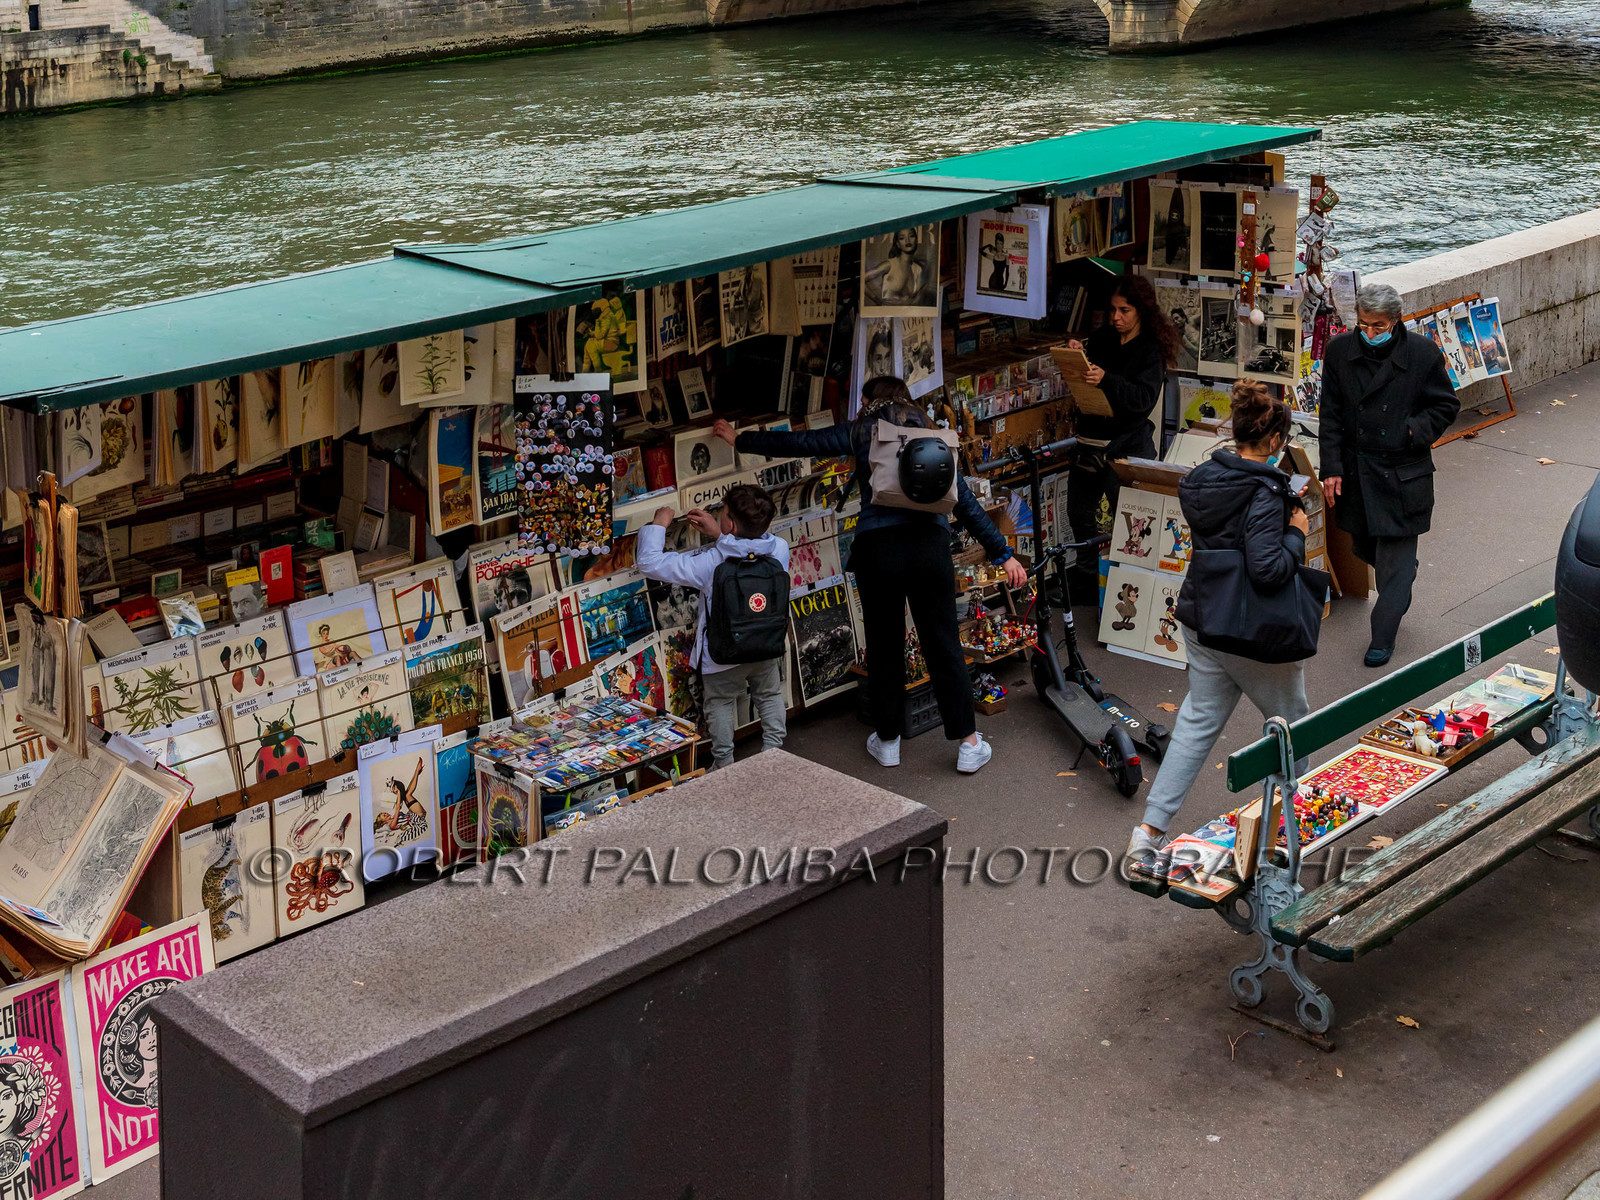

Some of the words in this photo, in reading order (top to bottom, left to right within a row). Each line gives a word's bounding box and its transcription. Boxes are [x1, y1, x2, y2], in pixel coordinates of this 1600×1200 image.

[983, 221, 1005, 232] MOON
[1005, 223, 1025, 234] RIVER
[1121, 503, 1137, 512] LOUIS
[1138, 505, 1158, 515] VUITTON
[475, 560, 499, 572] DRIVES
[476, 554, 535, 584] PORSCHE
[790, 583, 848, 620] VOGUE
[107, 654, 142, 669] MEDICINALES
[407, 664, 425, 679] TOUR
[426, 661, 437, 673] DE
[440, 652, 464, 669] FRANCE
[465, 648, 483, 663] 1950
[235, 698, 257, 710] REPTILES
[236, 705, 259, 717] INSECTES
[11, 862, 30, 879] PARIS
[87, 950, 150, 1033] MAKE
[156, 930, 198, 980] ART
[103, 1101, 157, 1160] NOT
